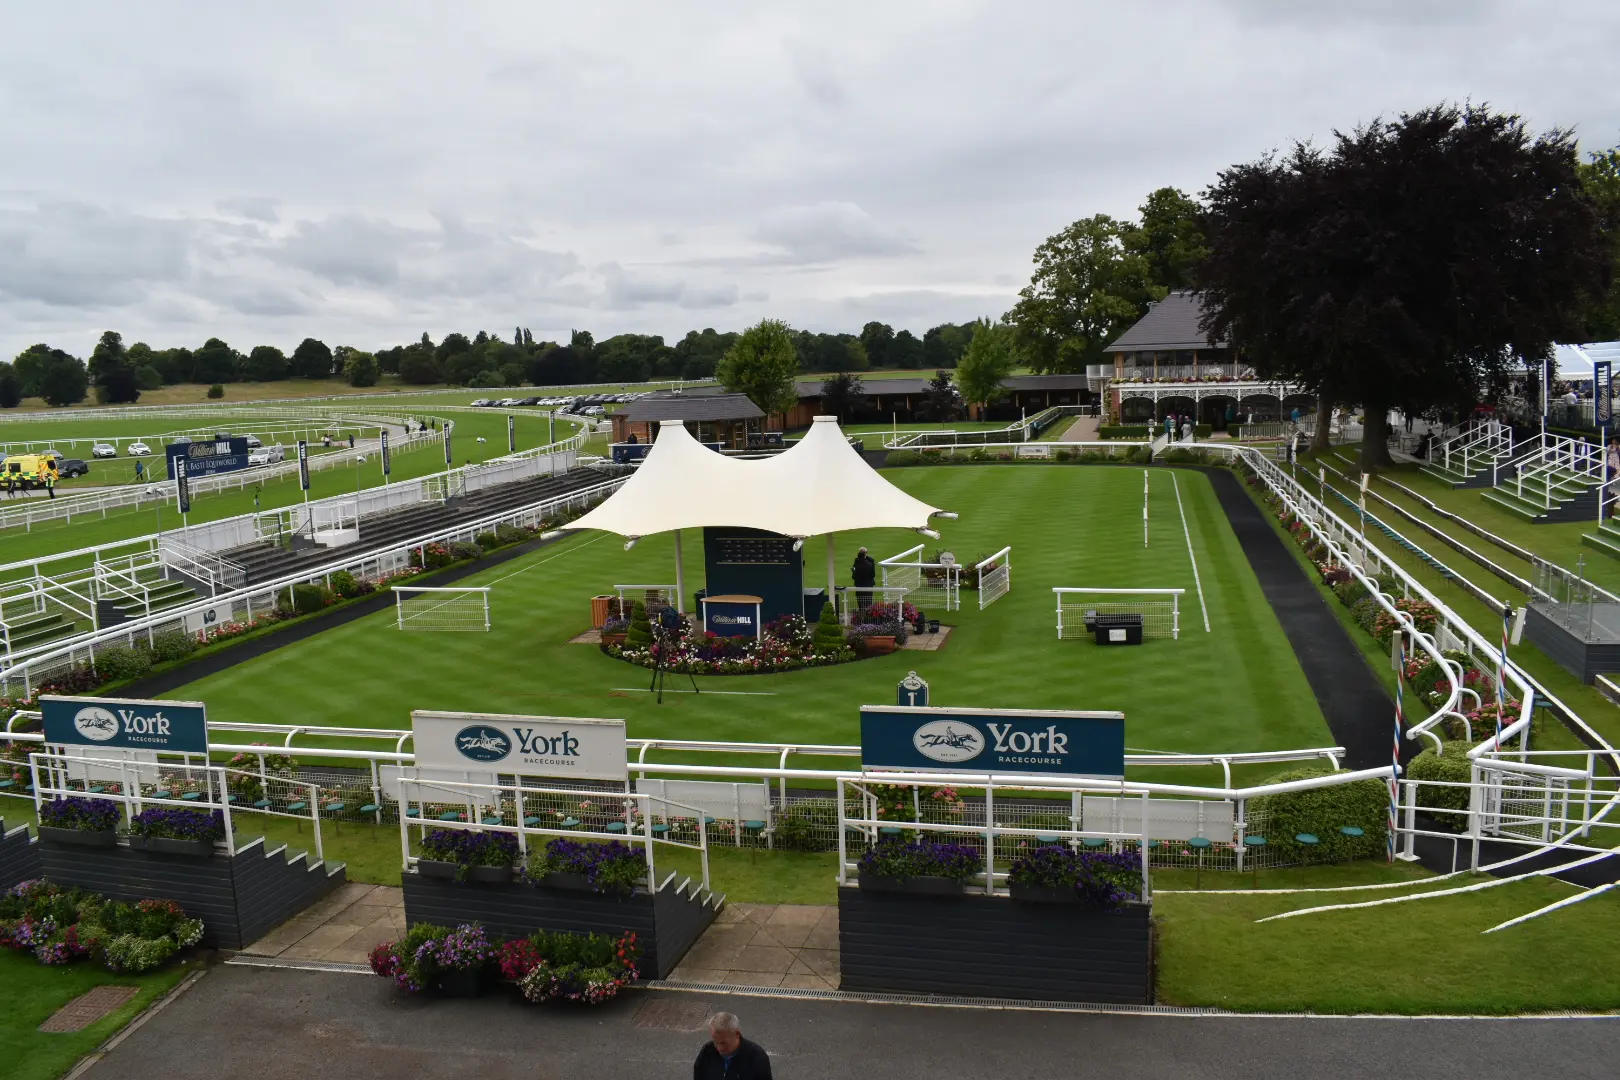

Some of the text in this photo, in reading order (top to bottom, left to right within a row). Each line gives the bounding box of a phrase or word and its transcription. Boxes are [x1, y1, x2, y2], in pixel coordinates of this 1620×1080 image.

[1598, 366, 1607, 385] HILL
[188, 442, 231, 458] William HILL
[190, 462, 205, 470] BASTI
[712, 615, 751, 624] William HILL
[118, 709, 172, 736] York
[128, 736, 168, 744] RACECOURSE
[512, 727, 580, 756] York
[986, 722, 1069, 754] York
[524, 757, 575, 766] RACECOURSE
[998, 756, 1062, 765] RACECOURSE
